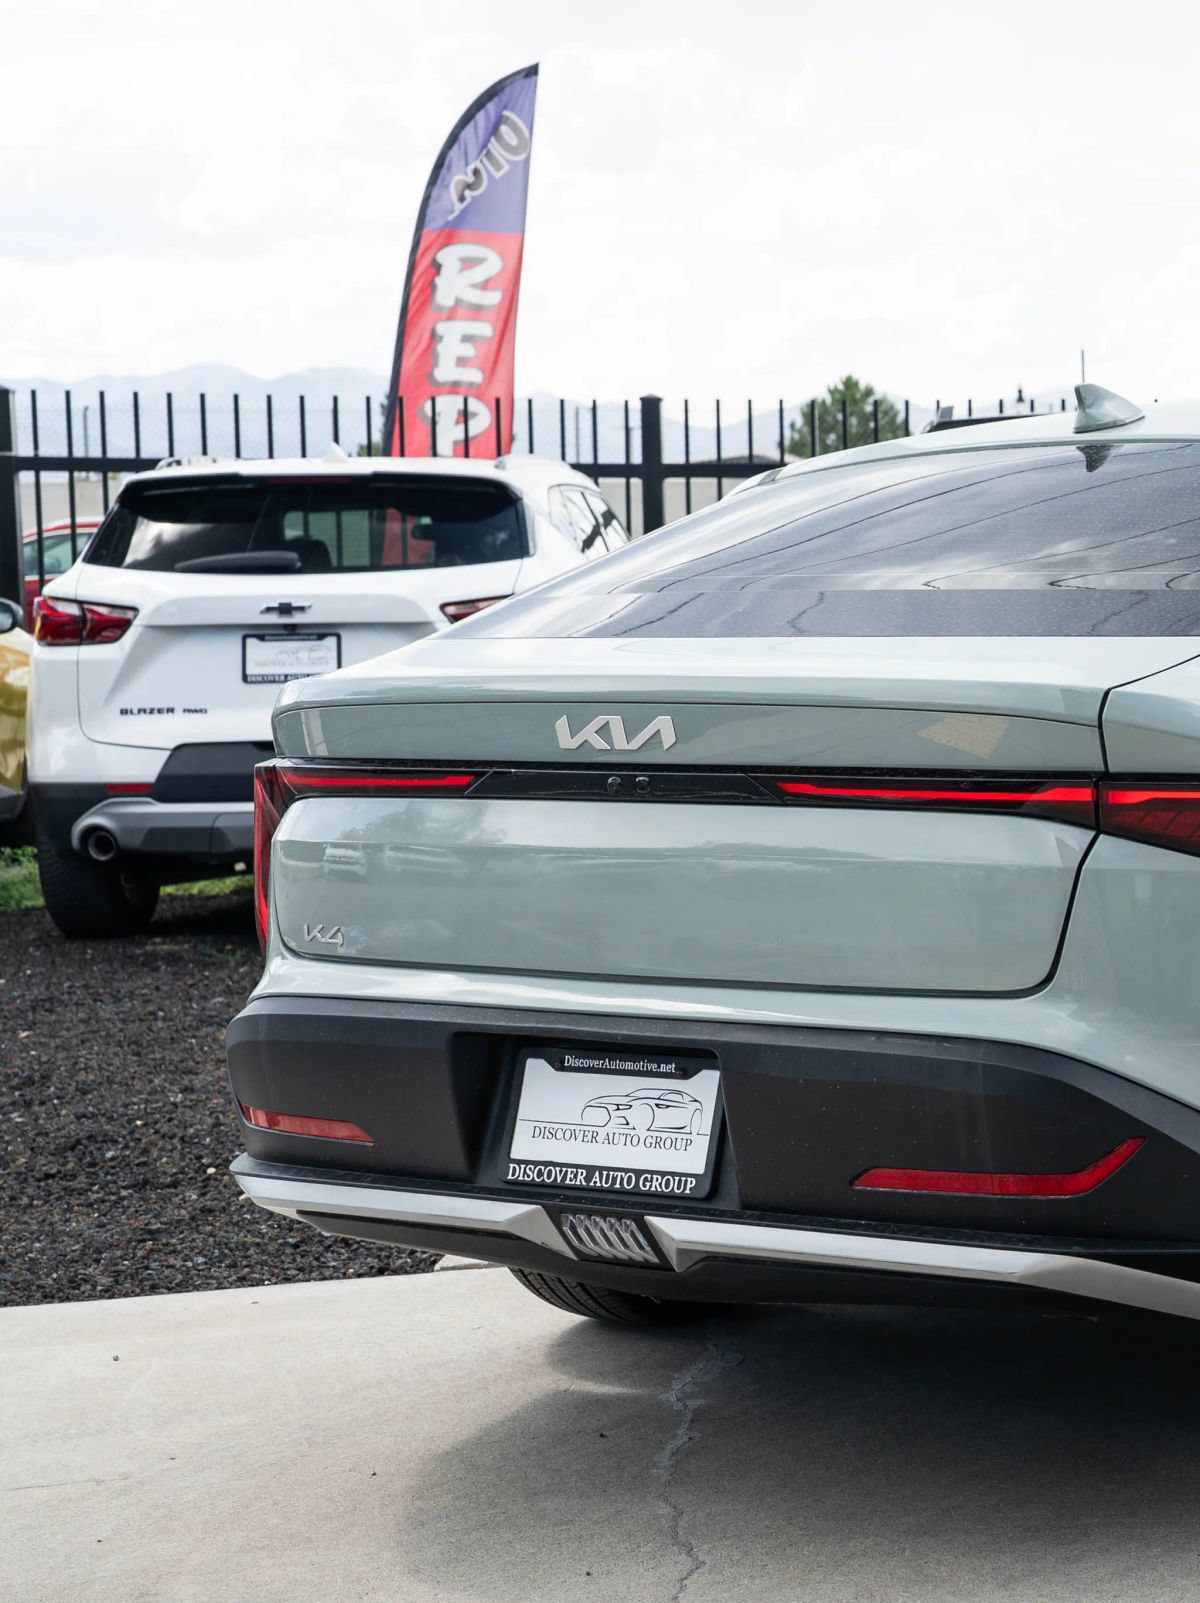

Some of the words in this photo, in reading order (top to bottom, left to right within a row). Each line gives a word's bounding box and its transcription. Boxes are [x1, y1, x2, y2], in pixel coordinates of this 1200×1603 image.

[120, 707, 175, 716] BLAZER
[555, 715, 676, 750] KIA
[304, 923, 344, 946] K4
[564, 1055, 676, 1073] DiscoverAutomotive.net
[532, 1125, 599, 1144] DISCOVER
[602, 1132, 640, 1147] AUTO
[643, 1136, 693, 1151] GROUP
[507, 1163, 587, 1186] DISCOVER
[590, 1170, 635, 1189] AUTO
[639, 1174, 696, 1194] GROUP
